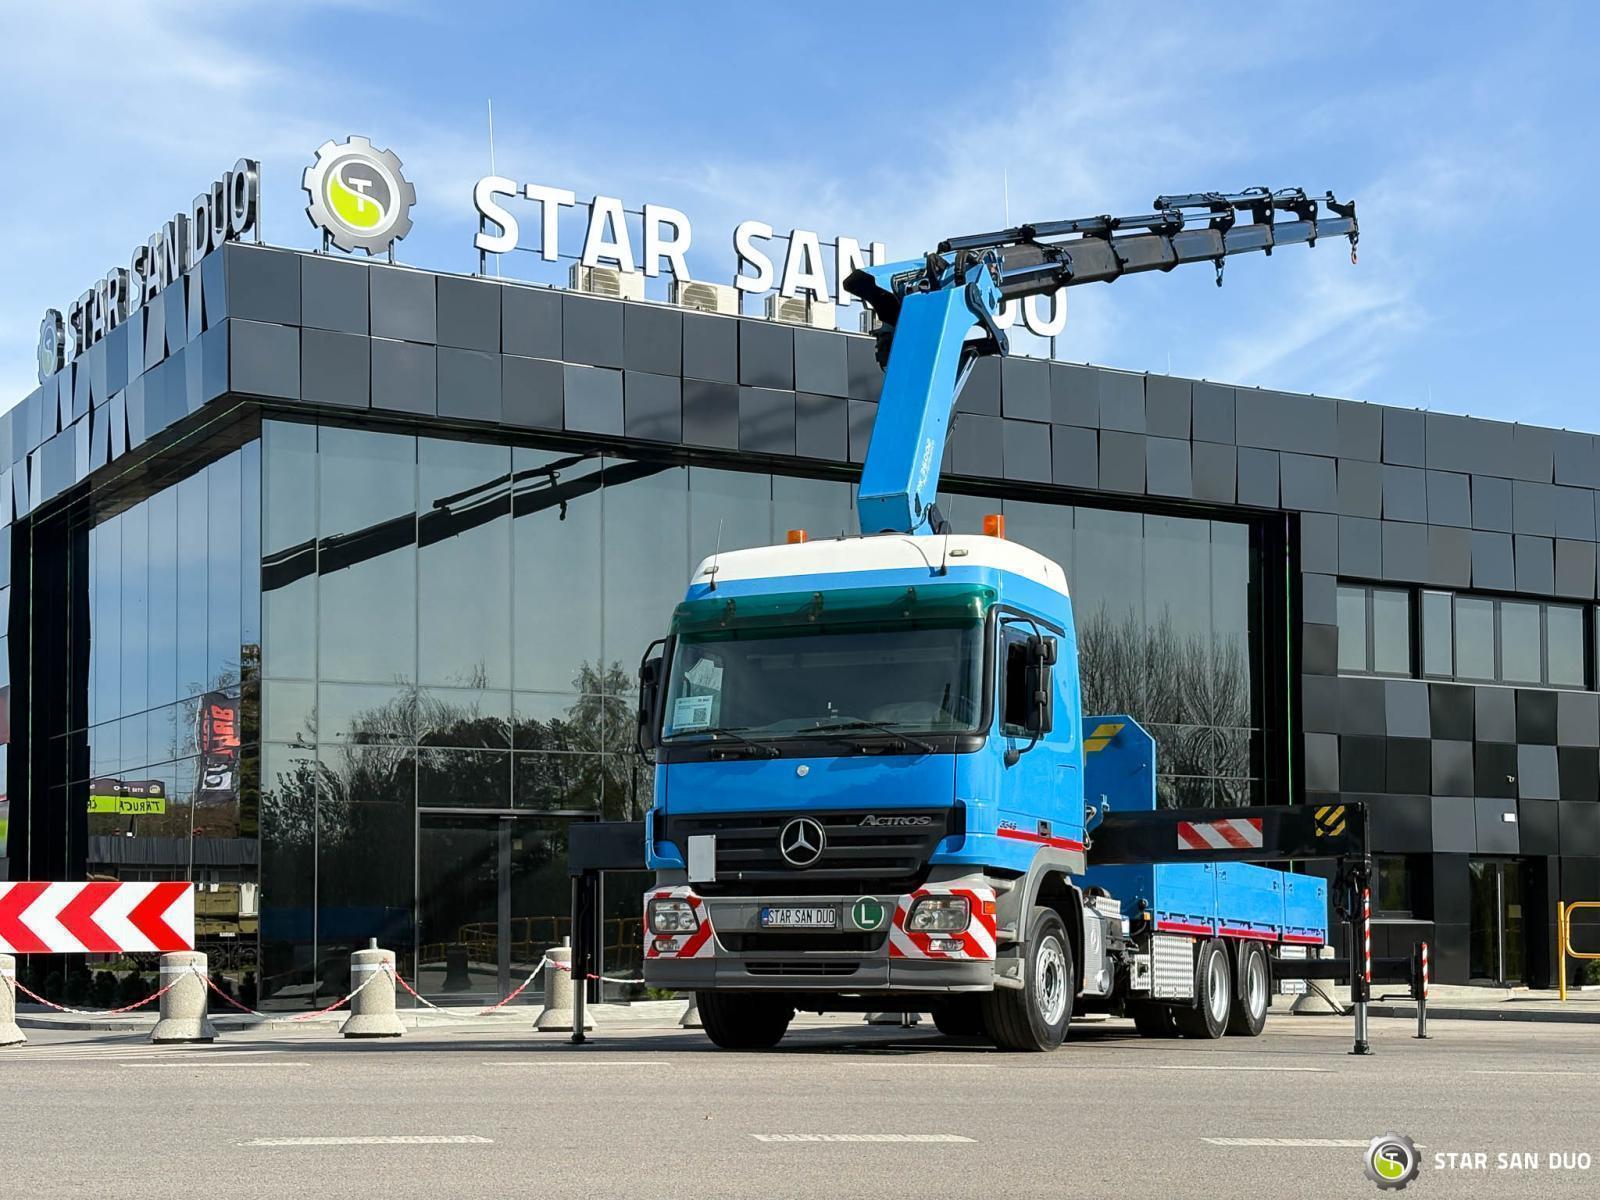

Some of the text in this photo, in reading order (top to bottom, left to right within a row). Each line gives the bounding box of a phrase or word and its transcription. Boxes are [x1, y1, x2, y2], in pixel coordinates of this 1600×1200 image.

[67, 158, 257, 362] STAR SAN DUO
[473, 175, 886, 306] STAR SAN
[768, 909, 835, 924] STAR SAN DUO
[861, 903, 875, 924] L
